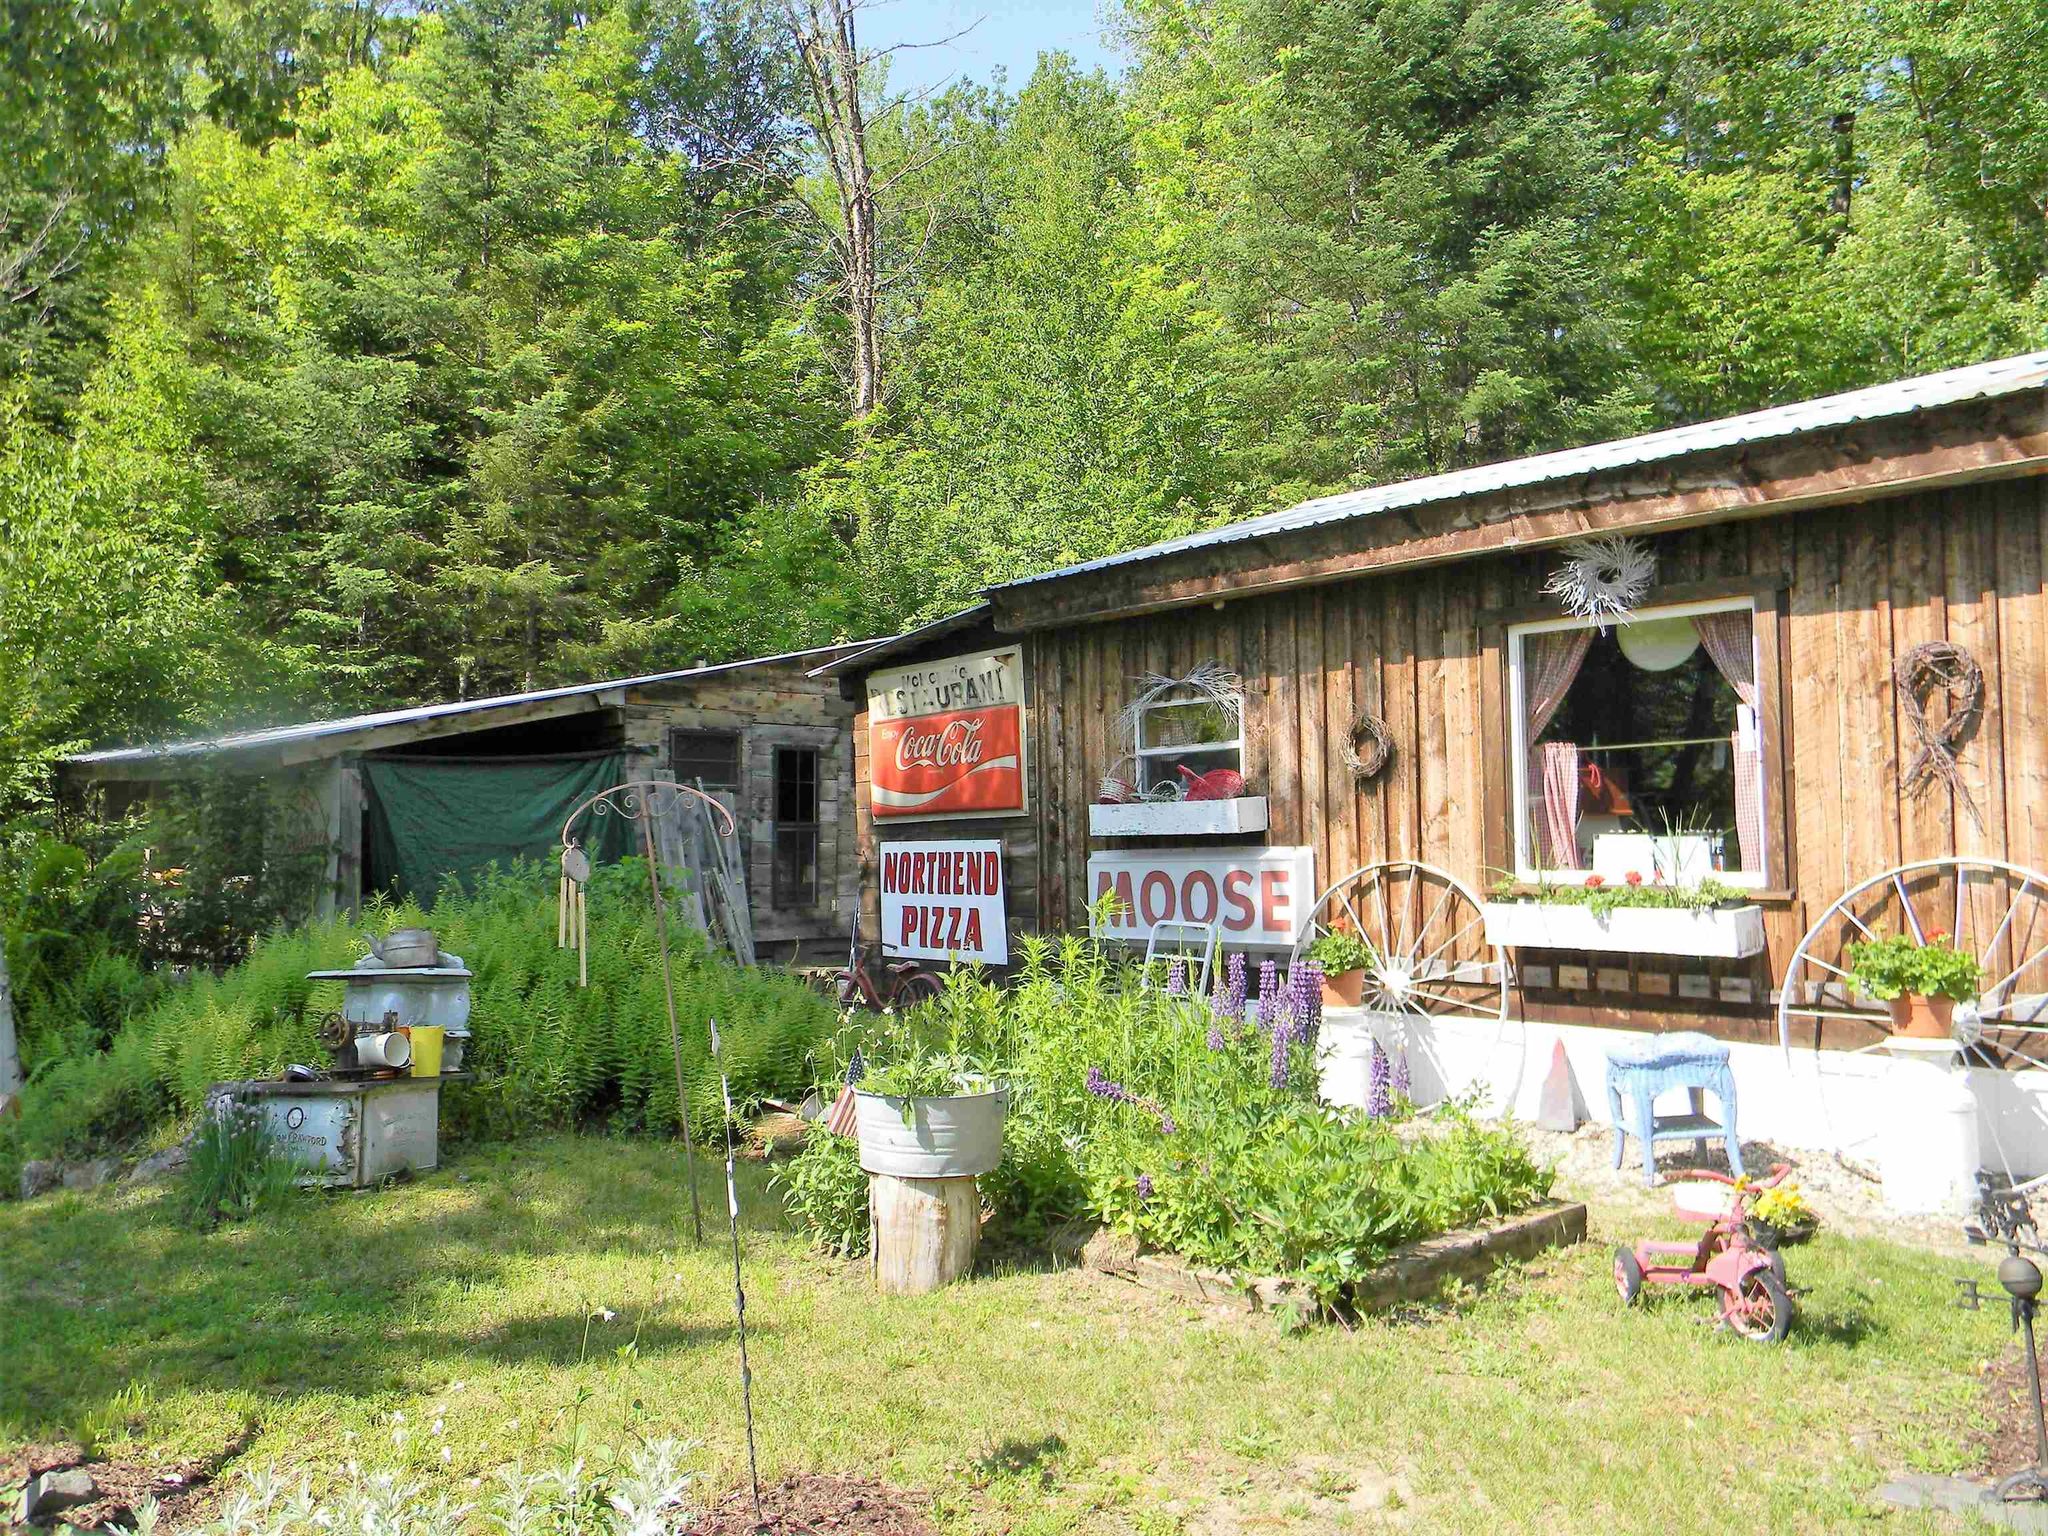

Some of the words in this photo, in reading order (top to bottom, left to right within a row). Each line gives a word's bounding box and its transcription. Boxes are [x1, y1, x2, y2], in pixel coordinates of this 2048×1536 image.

[870, 666, 1005, 716] STURANT
[895, 718, 986, 771] Coca-Cola
[884, 851, 999, 896] NORTHEND
[1096, 869, 1291, 932] MOOSE
[901, 905, 983, 952] PIZZA
